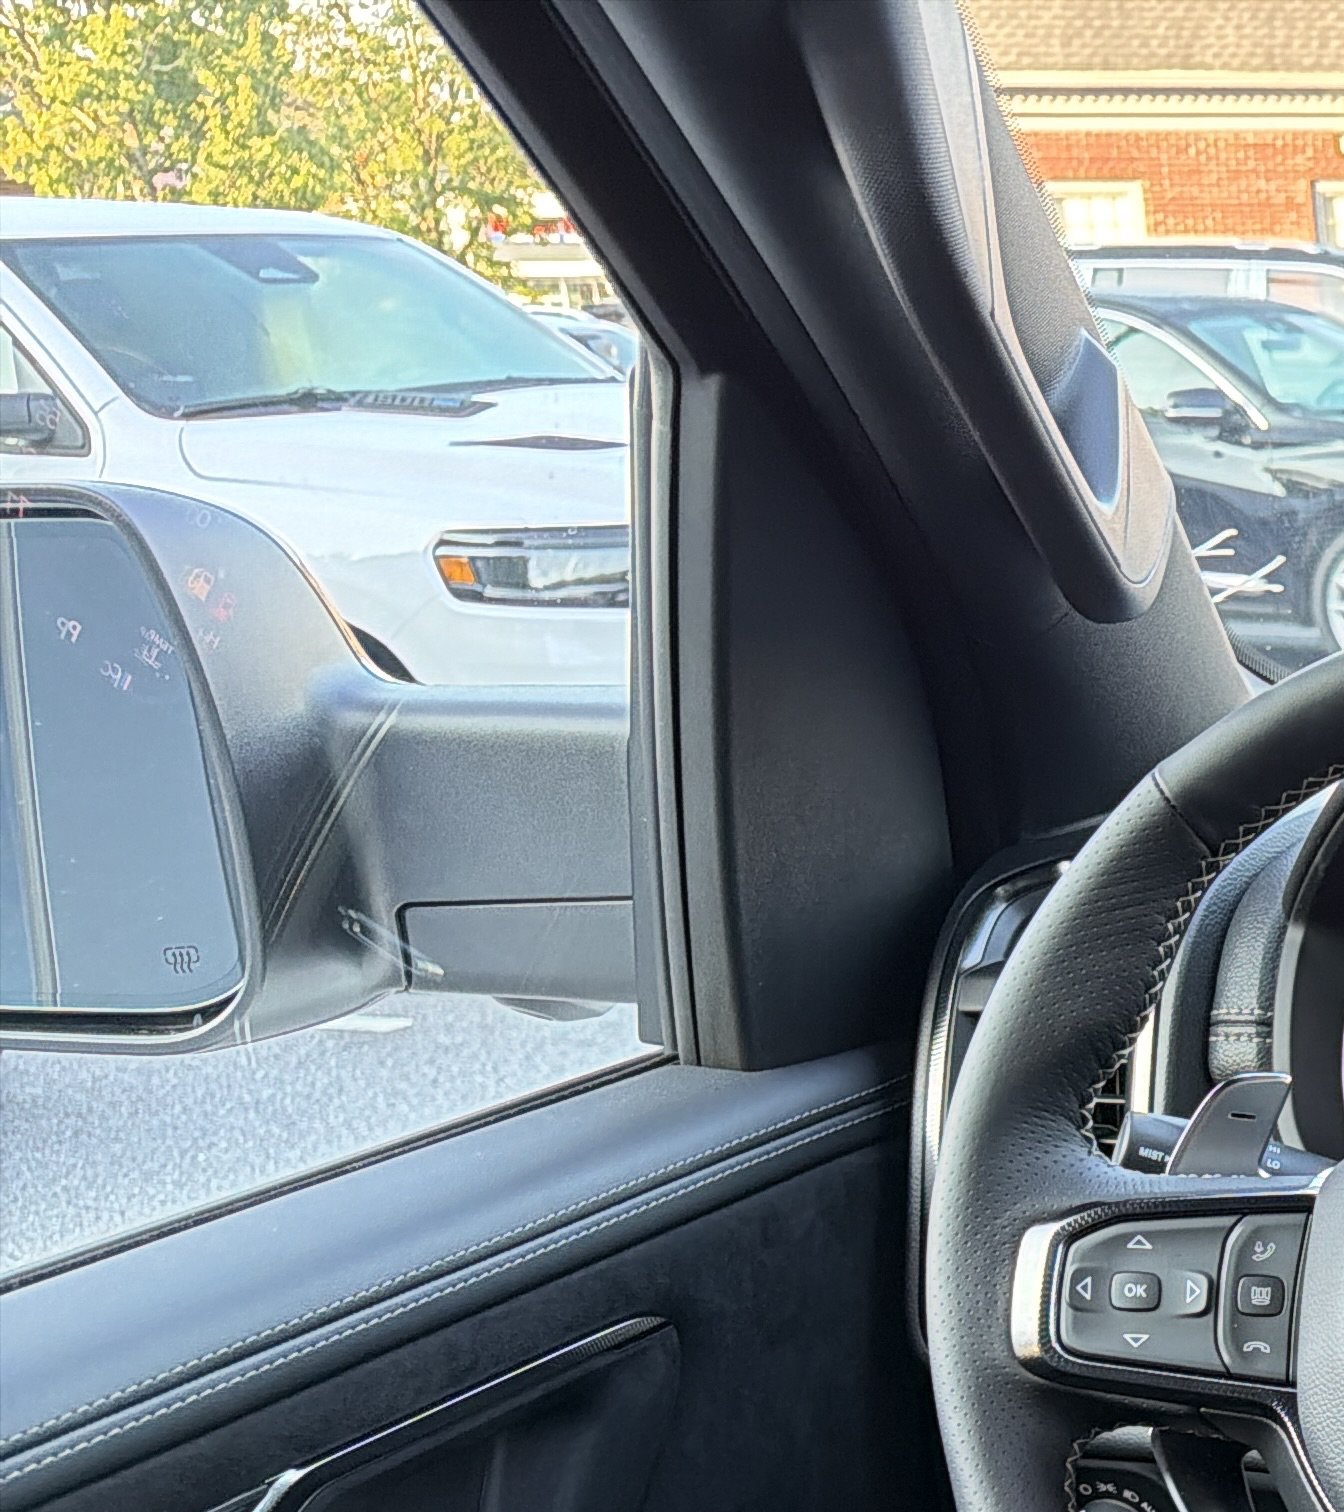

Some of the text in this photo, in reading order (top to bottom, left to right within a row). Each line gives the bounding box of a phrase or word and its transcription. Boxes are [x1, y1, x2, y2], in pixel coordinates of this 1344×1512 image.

[1138, 1147, 1165, 1161] MIST
[1266, 1158, 1281, 1170] LO
[1124, 1283, 1148, 1298] OK
